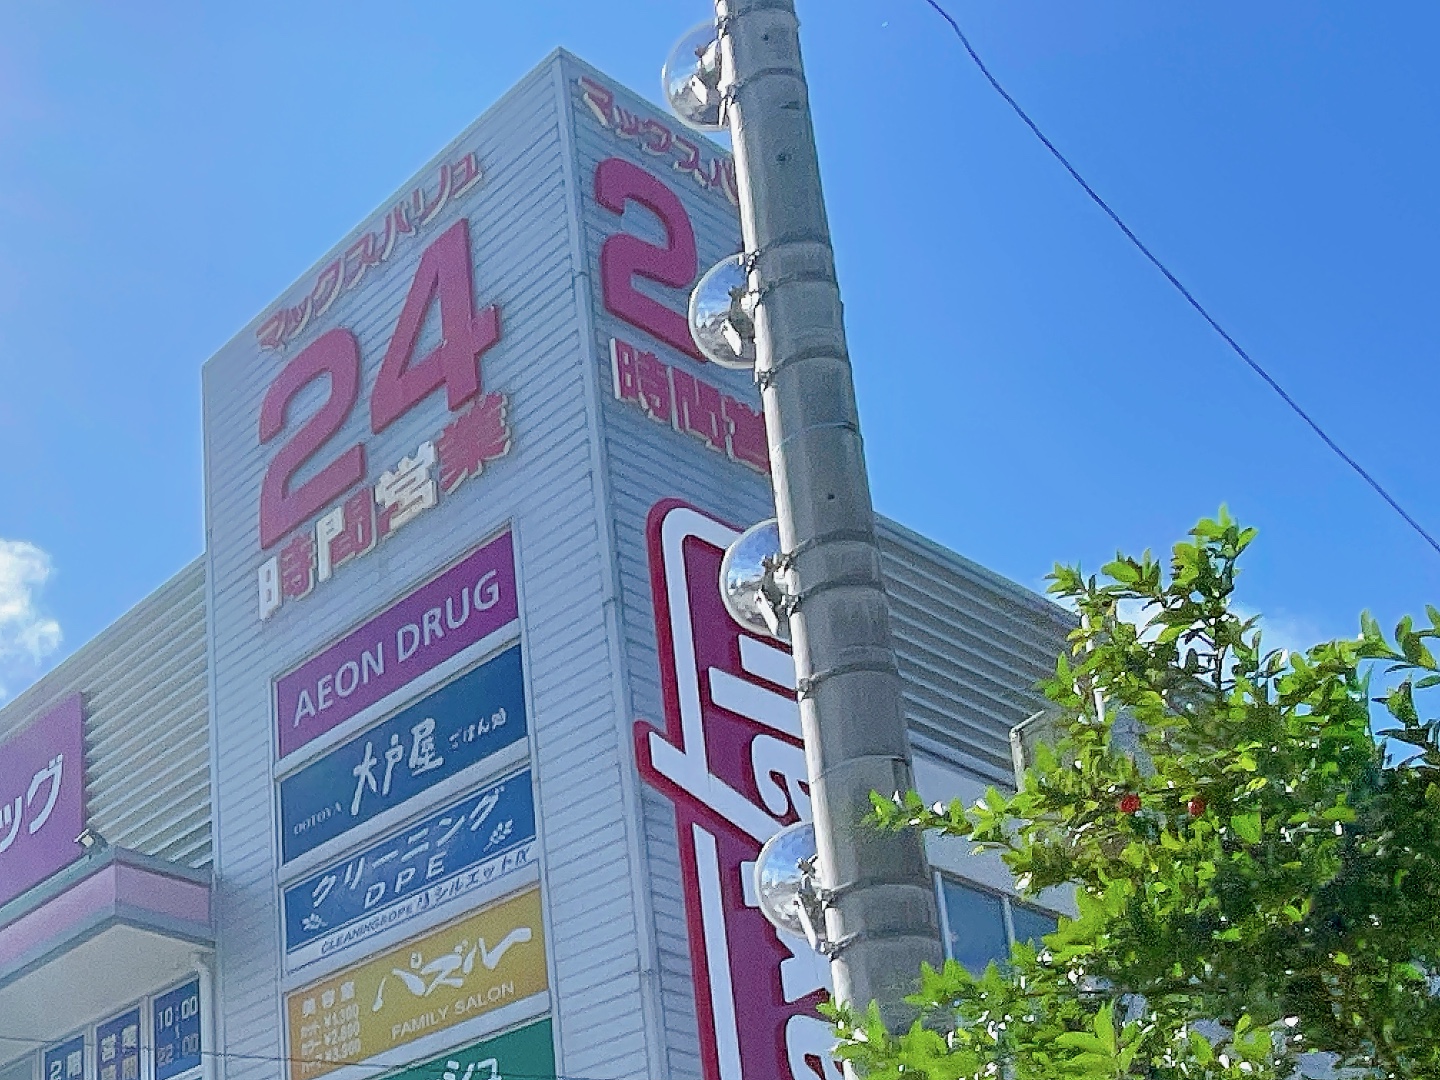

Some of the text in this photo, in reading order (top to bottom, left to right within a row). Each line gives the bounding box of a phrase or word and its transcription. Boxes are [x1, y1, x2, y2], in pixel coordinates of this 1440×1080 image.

[256, 152, 484, 352] マックスバリュ
[259, 217, 501, 550] 24
[257, 391, 514, 622] 時間営業
[293, 568, 500, 728] AEON DRUG
[351, 717, 444, 816] 大戸屋
[312, 785, 505, 908] クリーニング
[365, 852, 447, 908] DPE
[158, 995, 198, 1033] 10:00
[391, 982, 515, 1040] FAMILY SALON
